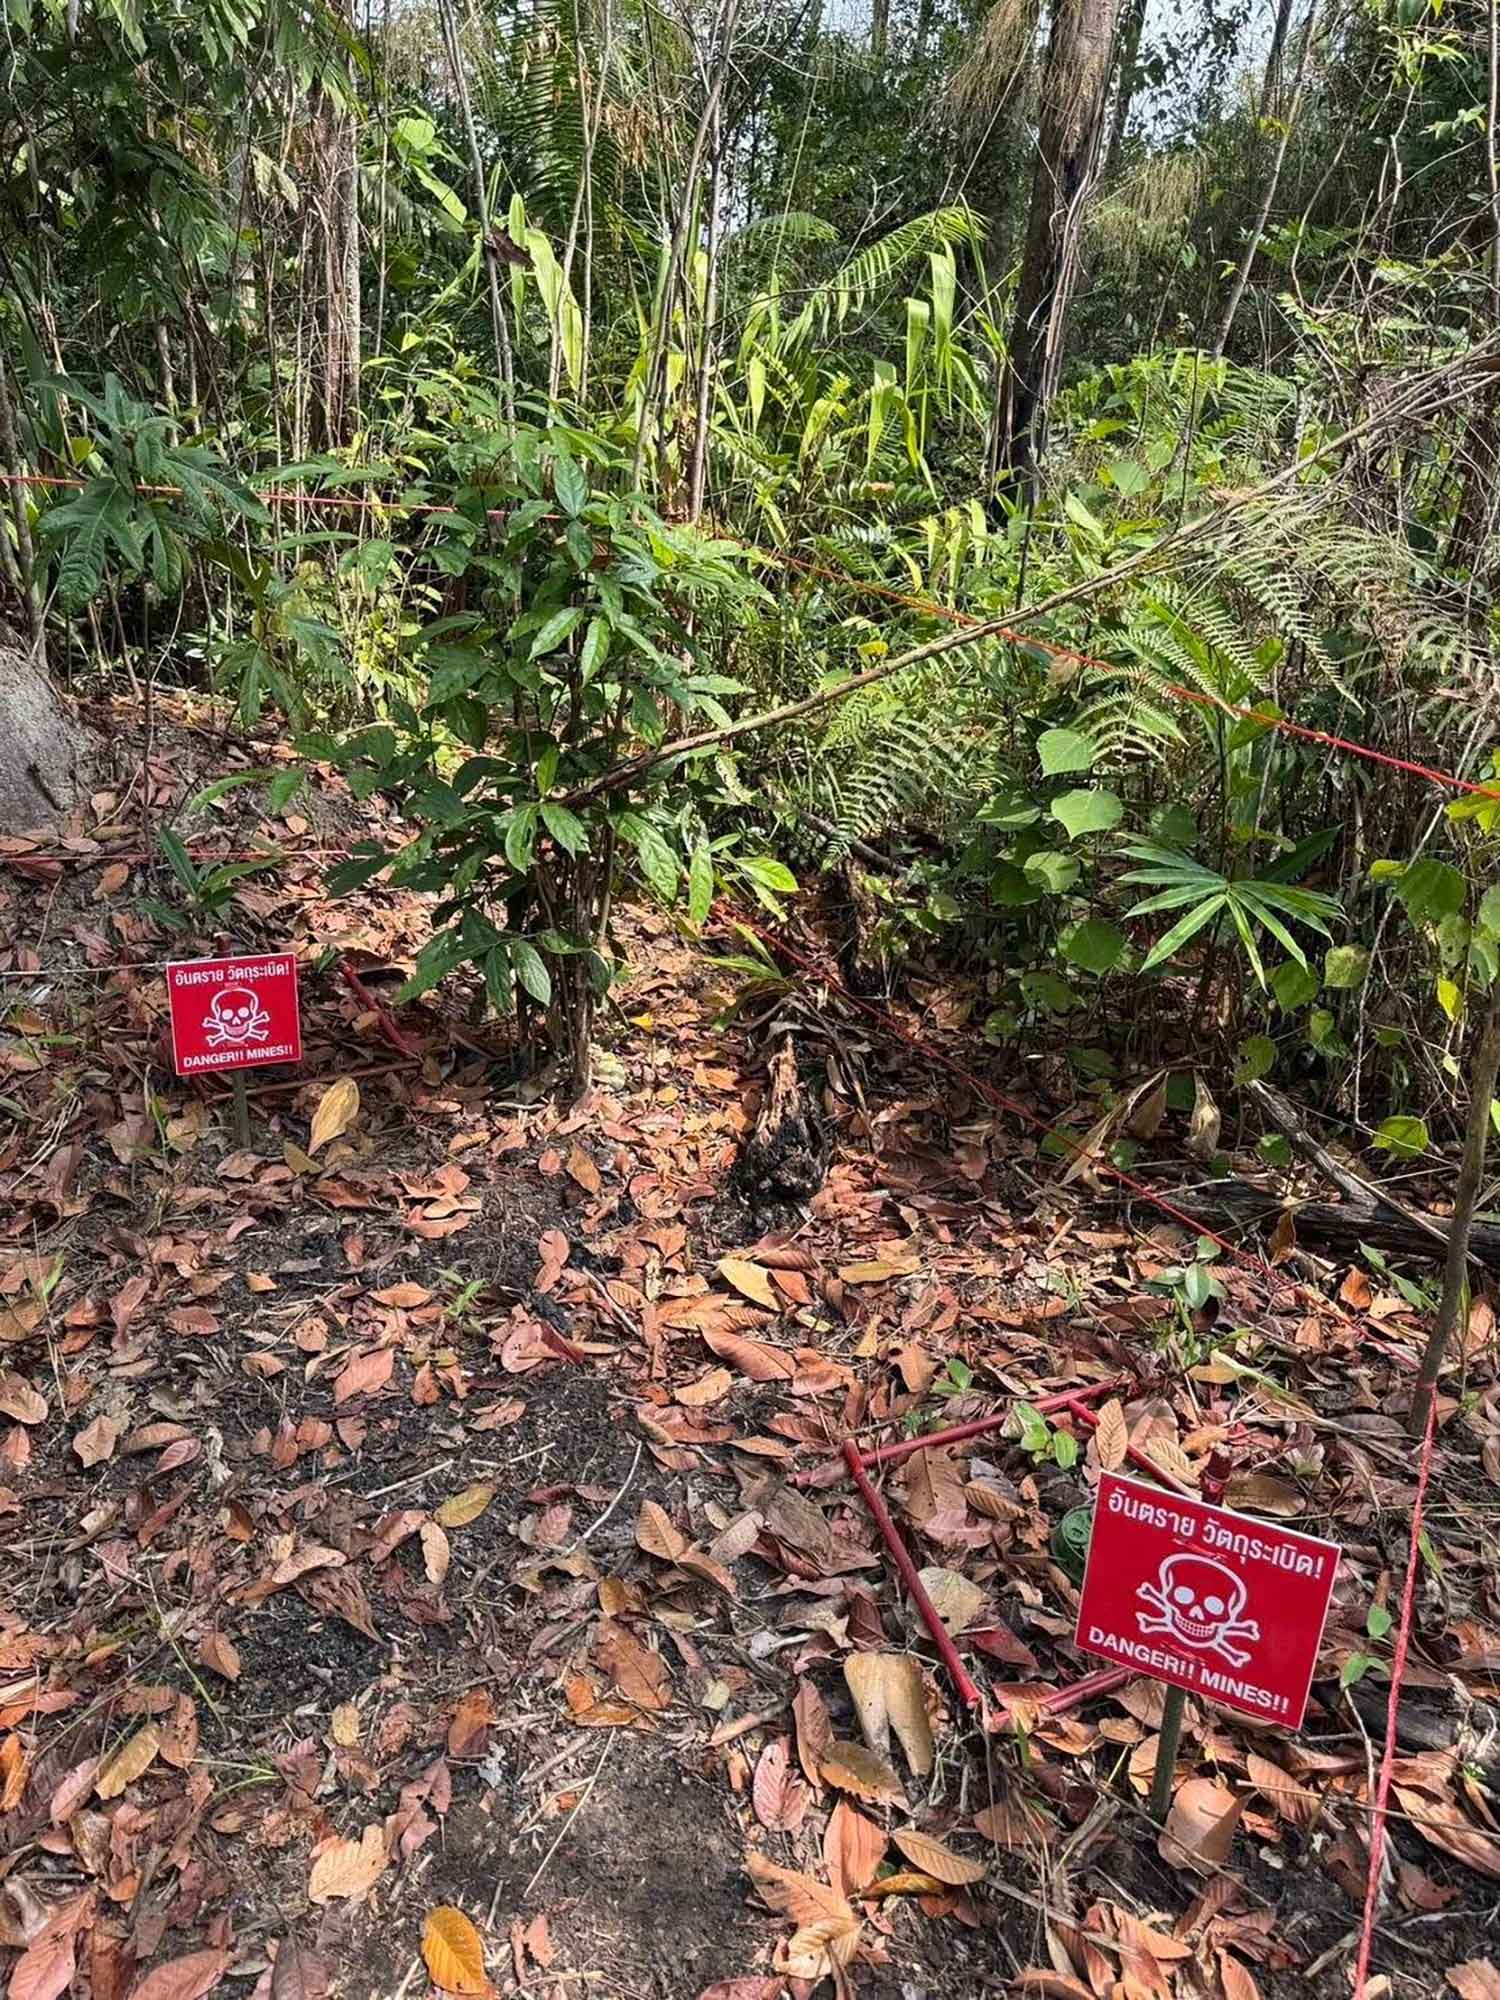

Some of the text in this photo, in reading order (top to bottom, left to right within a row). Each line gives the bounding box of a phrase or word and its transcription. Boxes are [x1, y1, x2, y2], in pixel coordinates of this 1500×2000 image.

[176, 969, 224, 986] อันตราย
[183, 1045, 293, 1068] DANGER!! MINES!!
[1108, 1487, 1325, 1579] อันตราย วัตถุระเบิด!
[1088, 1626, 1289, 1714] DANGER!! MINES!!
